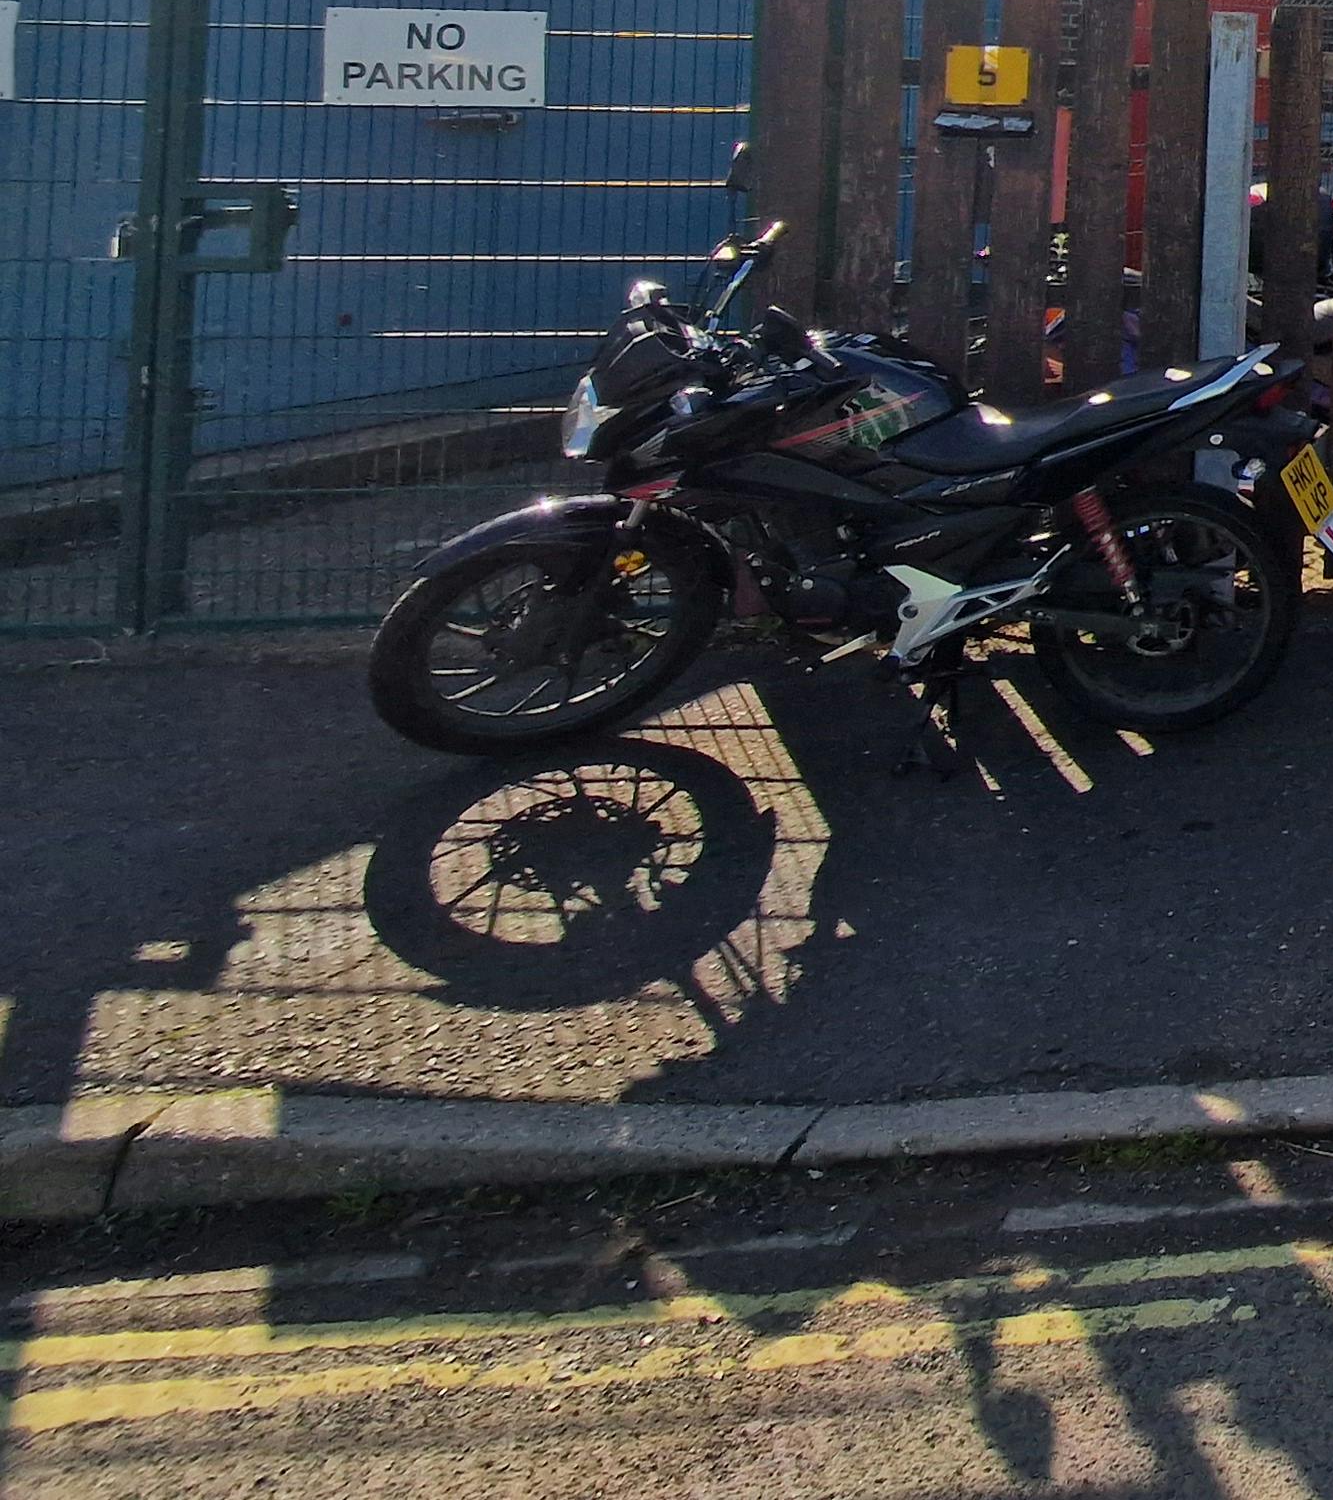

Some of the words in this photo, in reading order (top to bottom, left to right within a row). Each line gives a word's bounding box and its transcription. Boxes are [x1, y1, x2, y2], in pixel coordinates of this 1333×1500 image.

[407, 22, 466, 50] NO
[343, 62, 527, 92] PARKING
[1288, 451, 1319, 497] HK17
[1303, 482, 1330, 523] LKP
